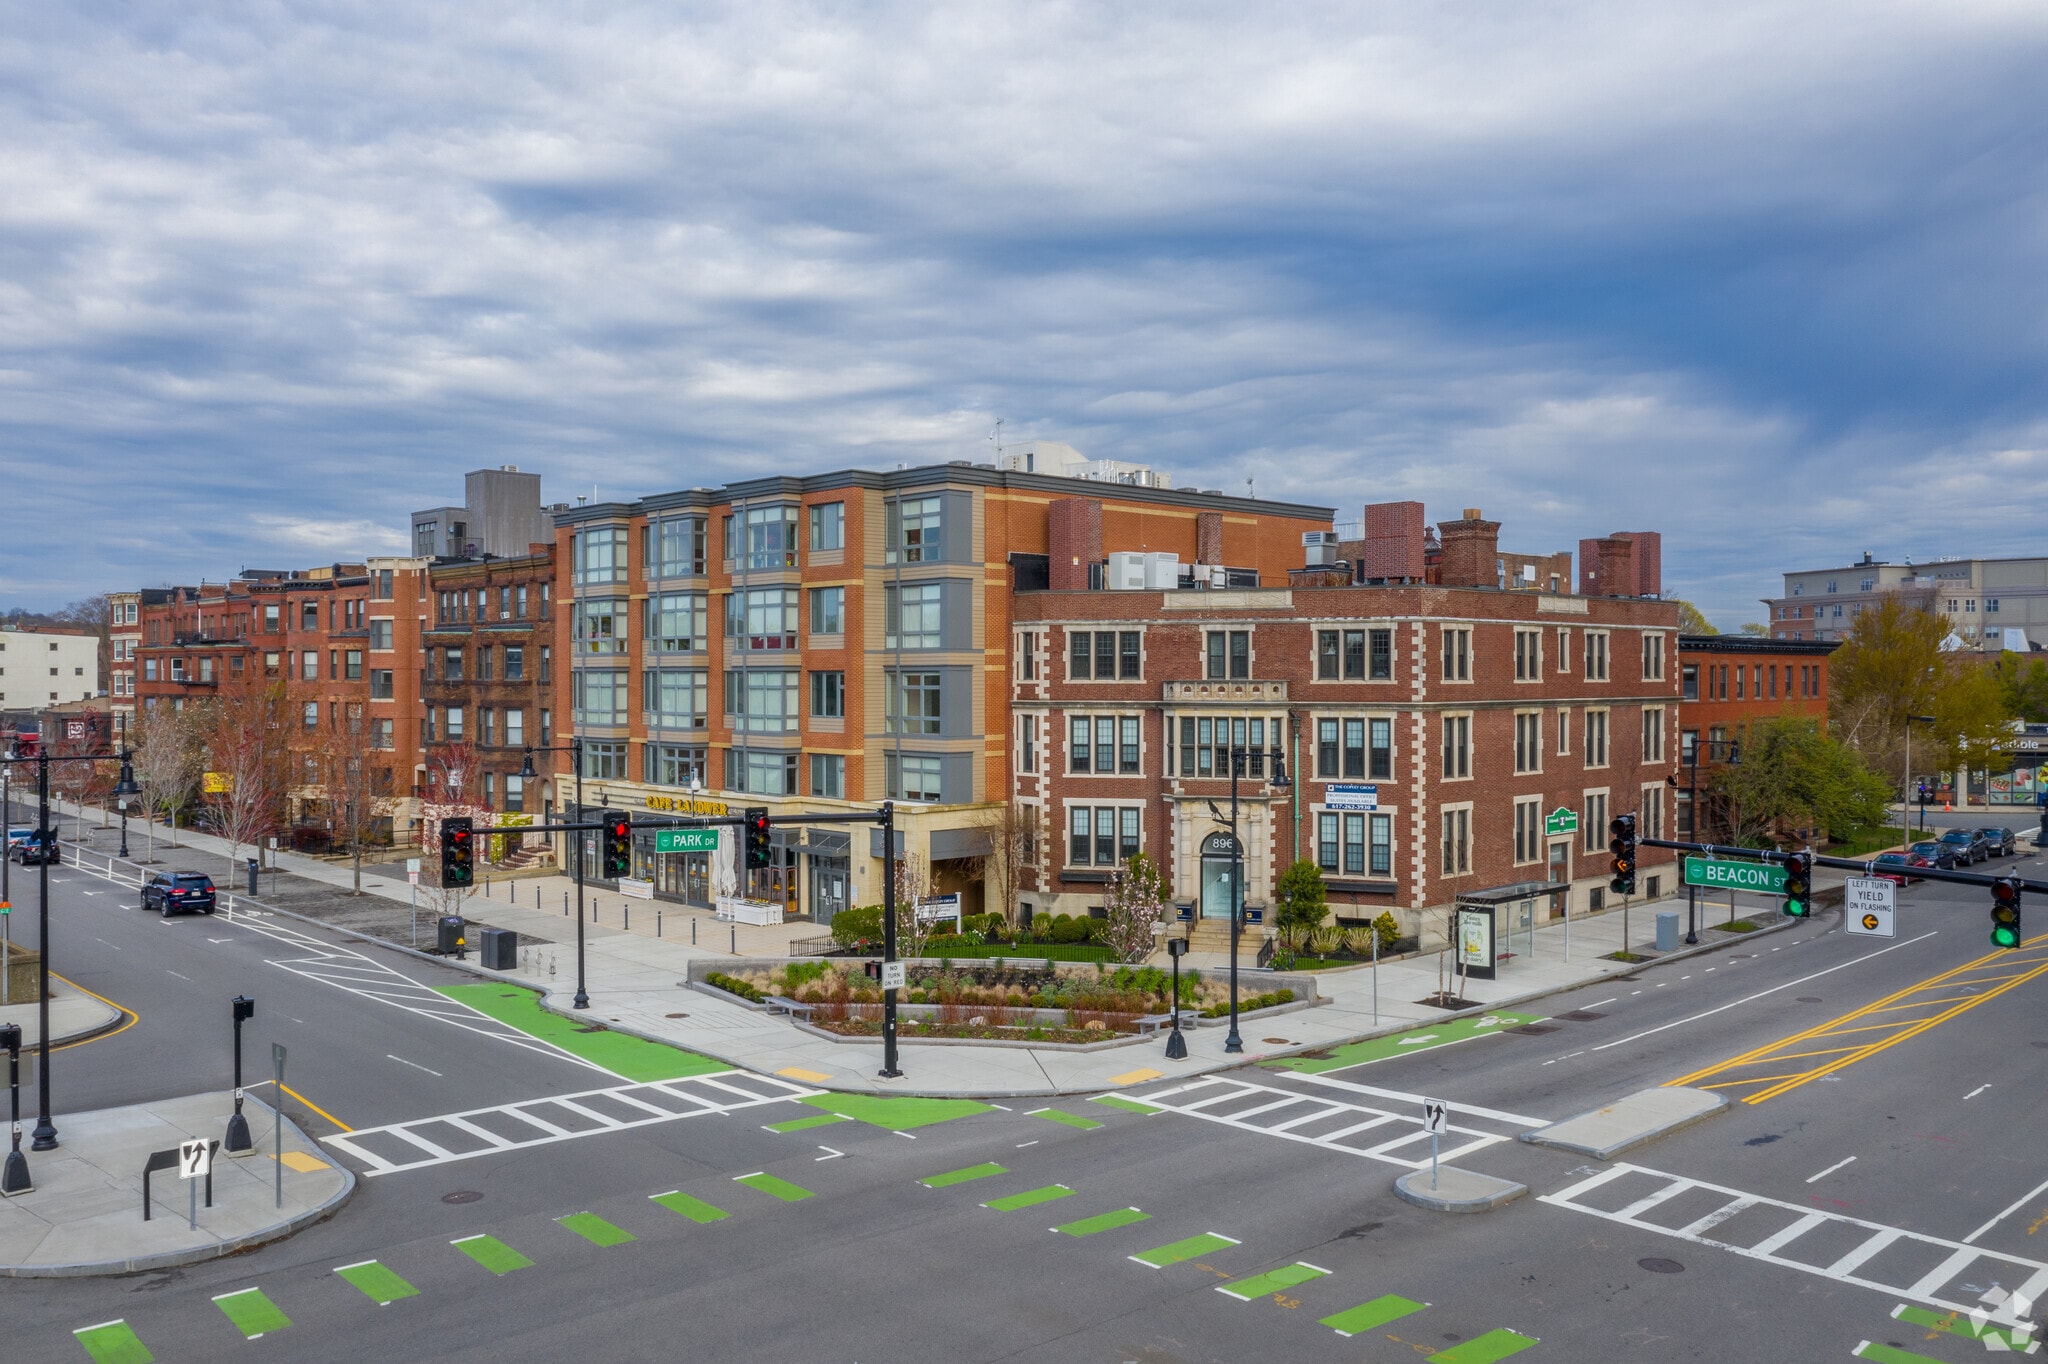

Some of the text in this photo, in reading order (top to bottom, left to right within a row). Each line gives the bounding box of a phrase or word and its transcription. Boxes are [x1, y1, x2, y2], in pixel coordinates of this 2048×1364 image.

[645, 795, 673, 810] CAFE
[677, 799, 728, 816] LANDWER
[673, 834, 715, 847] PARK DR
[1212, 838, 1232, 849] 896
[1706, 865, 1787, 887] BEACON ST
[1852, 880, 1889, 890] LEFT TURN
[1858, 890, 1884, 902] YIELD
[1860, 902, 1892, 912] FLASHING
